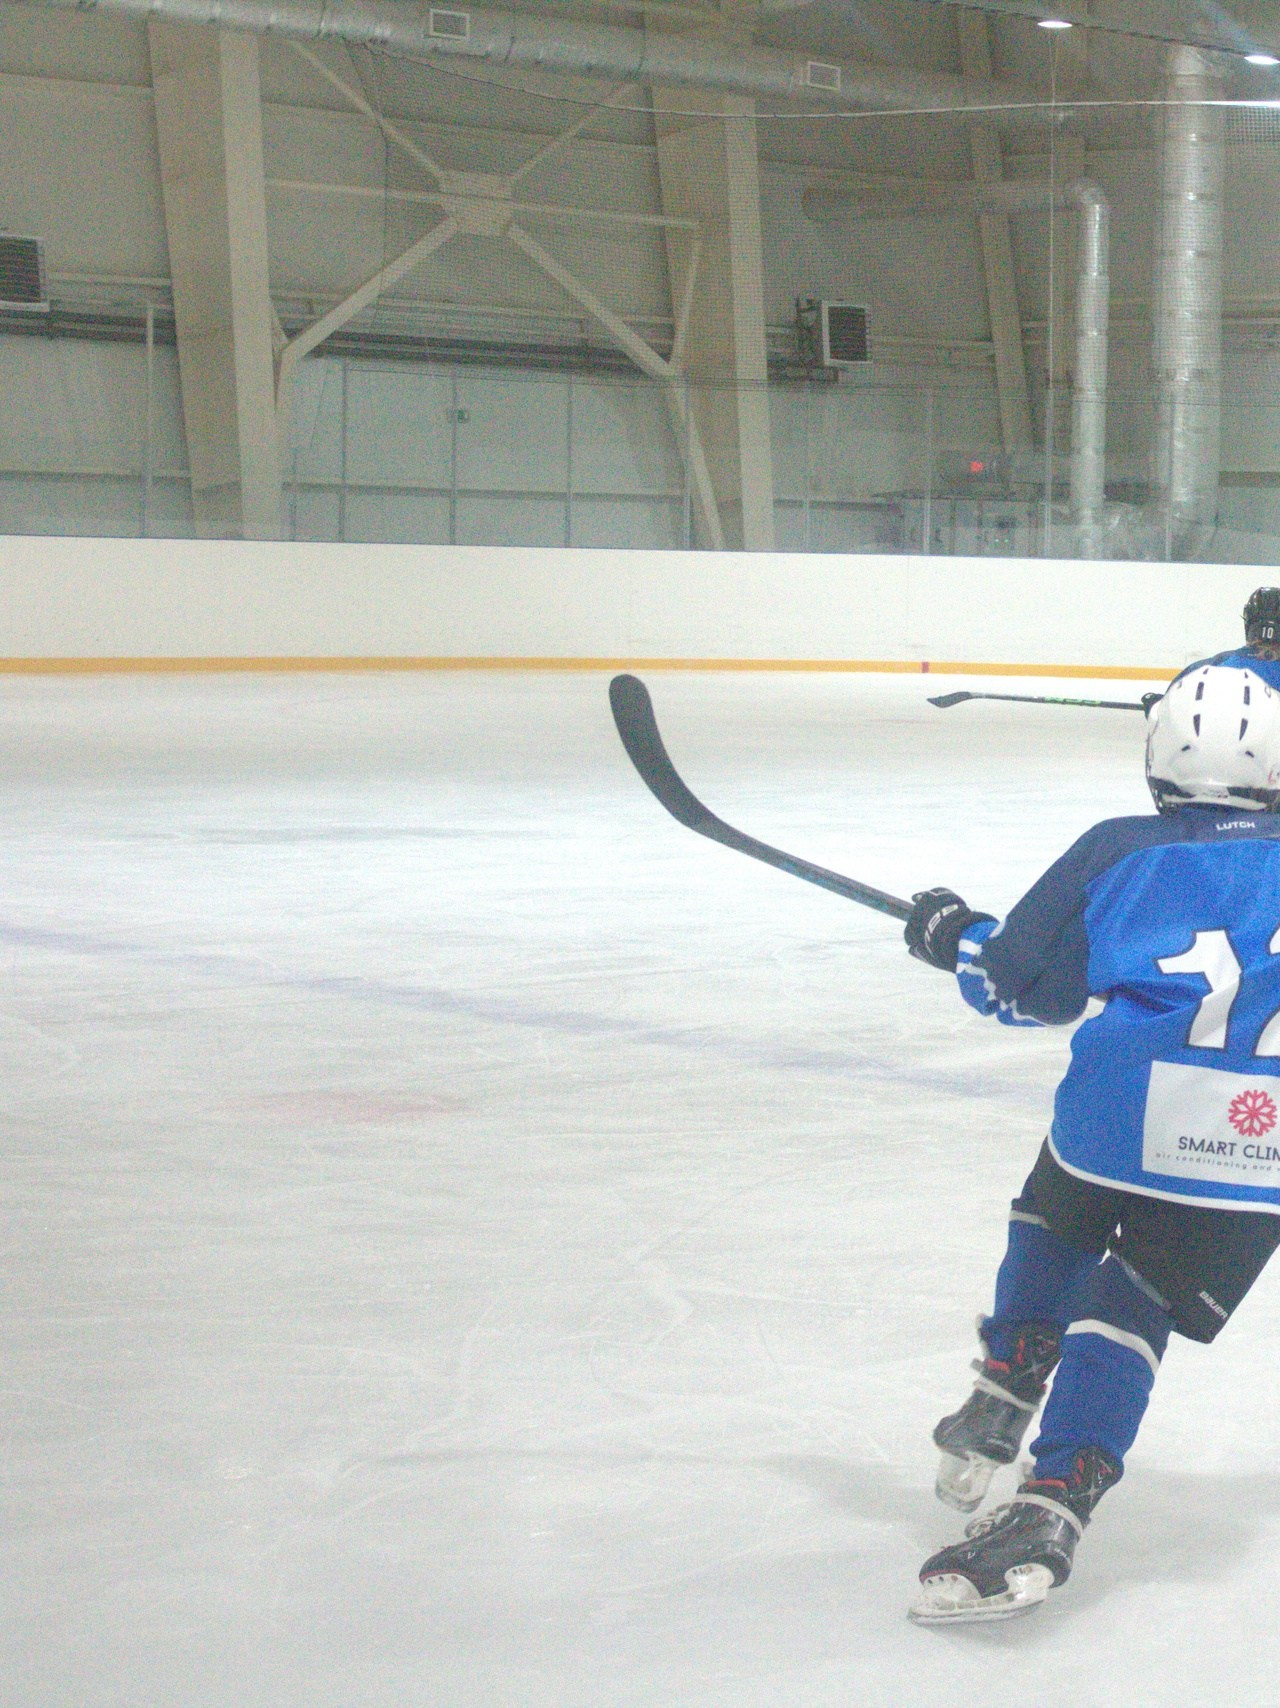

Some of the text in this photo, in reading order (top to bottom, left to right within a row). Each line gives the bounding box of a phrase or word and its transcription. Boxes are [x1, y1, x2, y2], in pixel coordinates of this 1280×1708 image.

[1261, 626, 1274, 639] 10
[1216, 821, 1256, 830] LUTCH
[1178, 1136, 1237, 1157] SMART
[1175, 1155, 1248, 1171] conditioning
